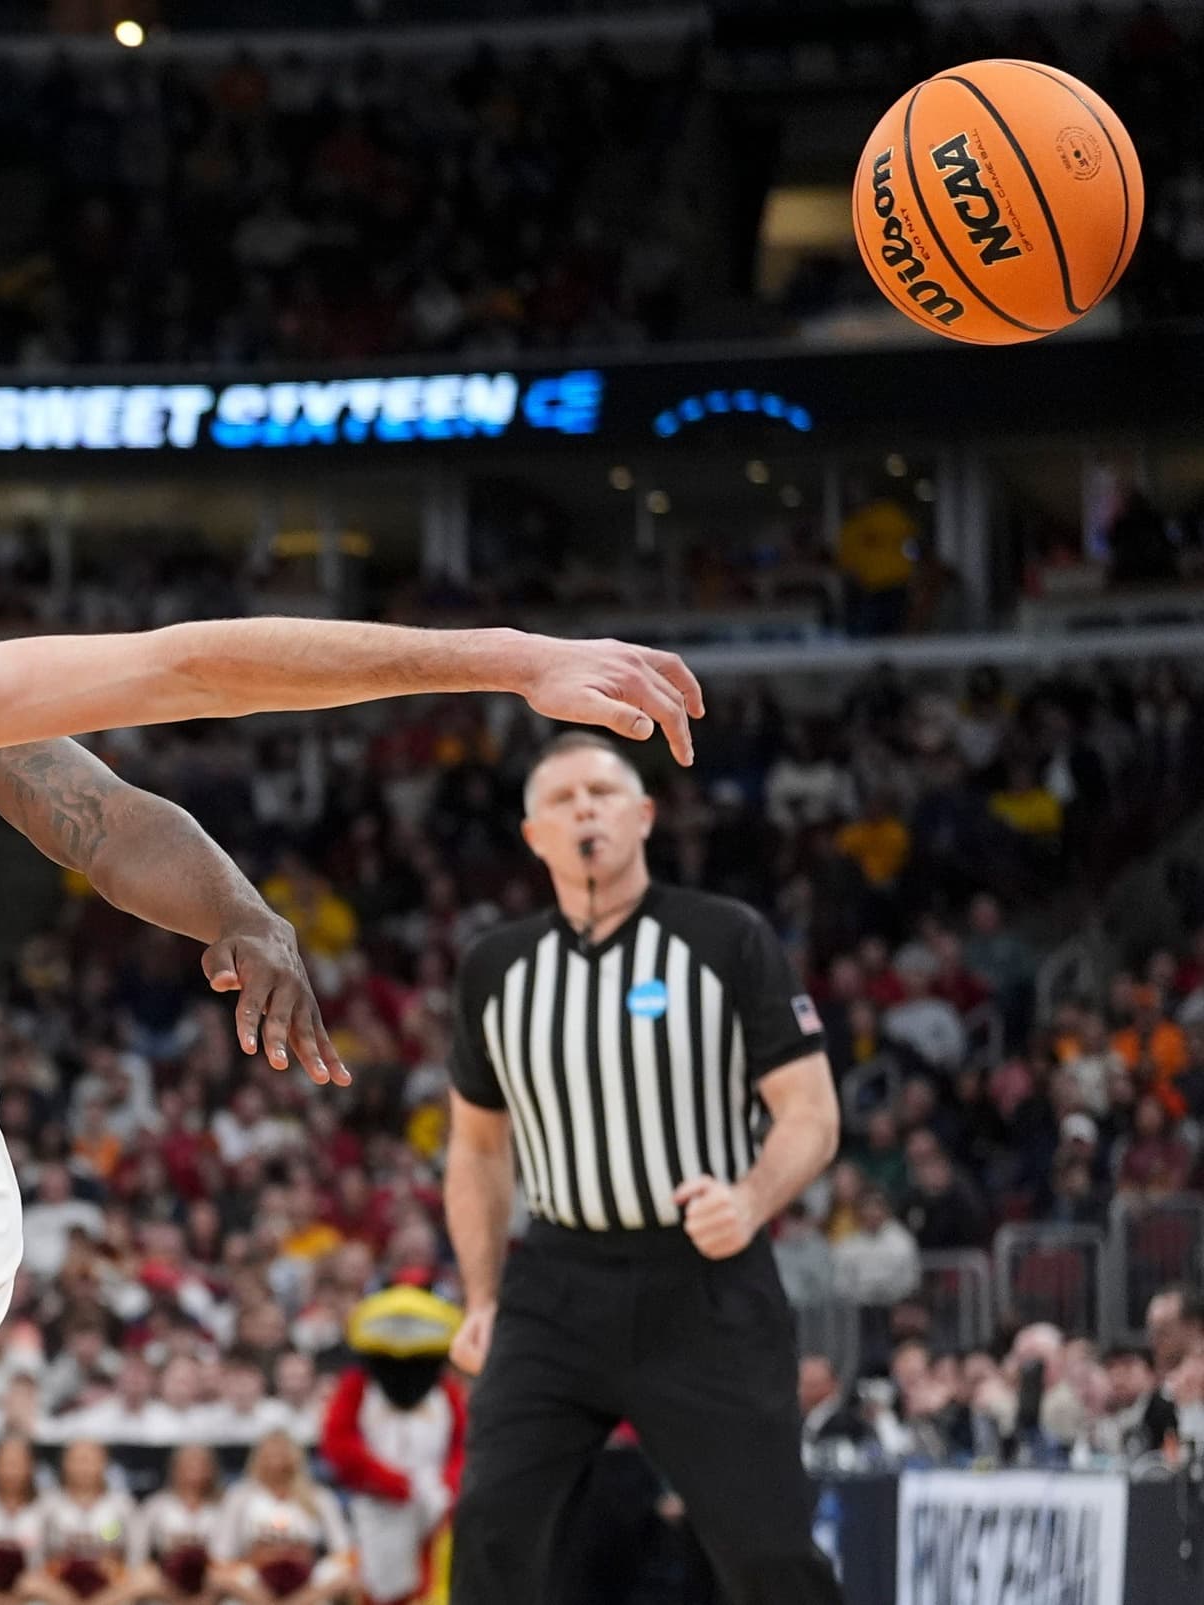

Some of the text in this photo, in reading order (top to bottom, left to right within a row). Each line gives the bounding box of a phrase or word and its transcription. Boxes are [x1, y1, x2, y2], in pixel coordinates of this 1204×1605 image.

[872, 146, 965, 326] Wilson
[899, 207, 931, 261] EVO NXT
[931, 131, 1023, 266] NCAA
[972, 128, 1035, 252] OFFICIAL GAME BALL
